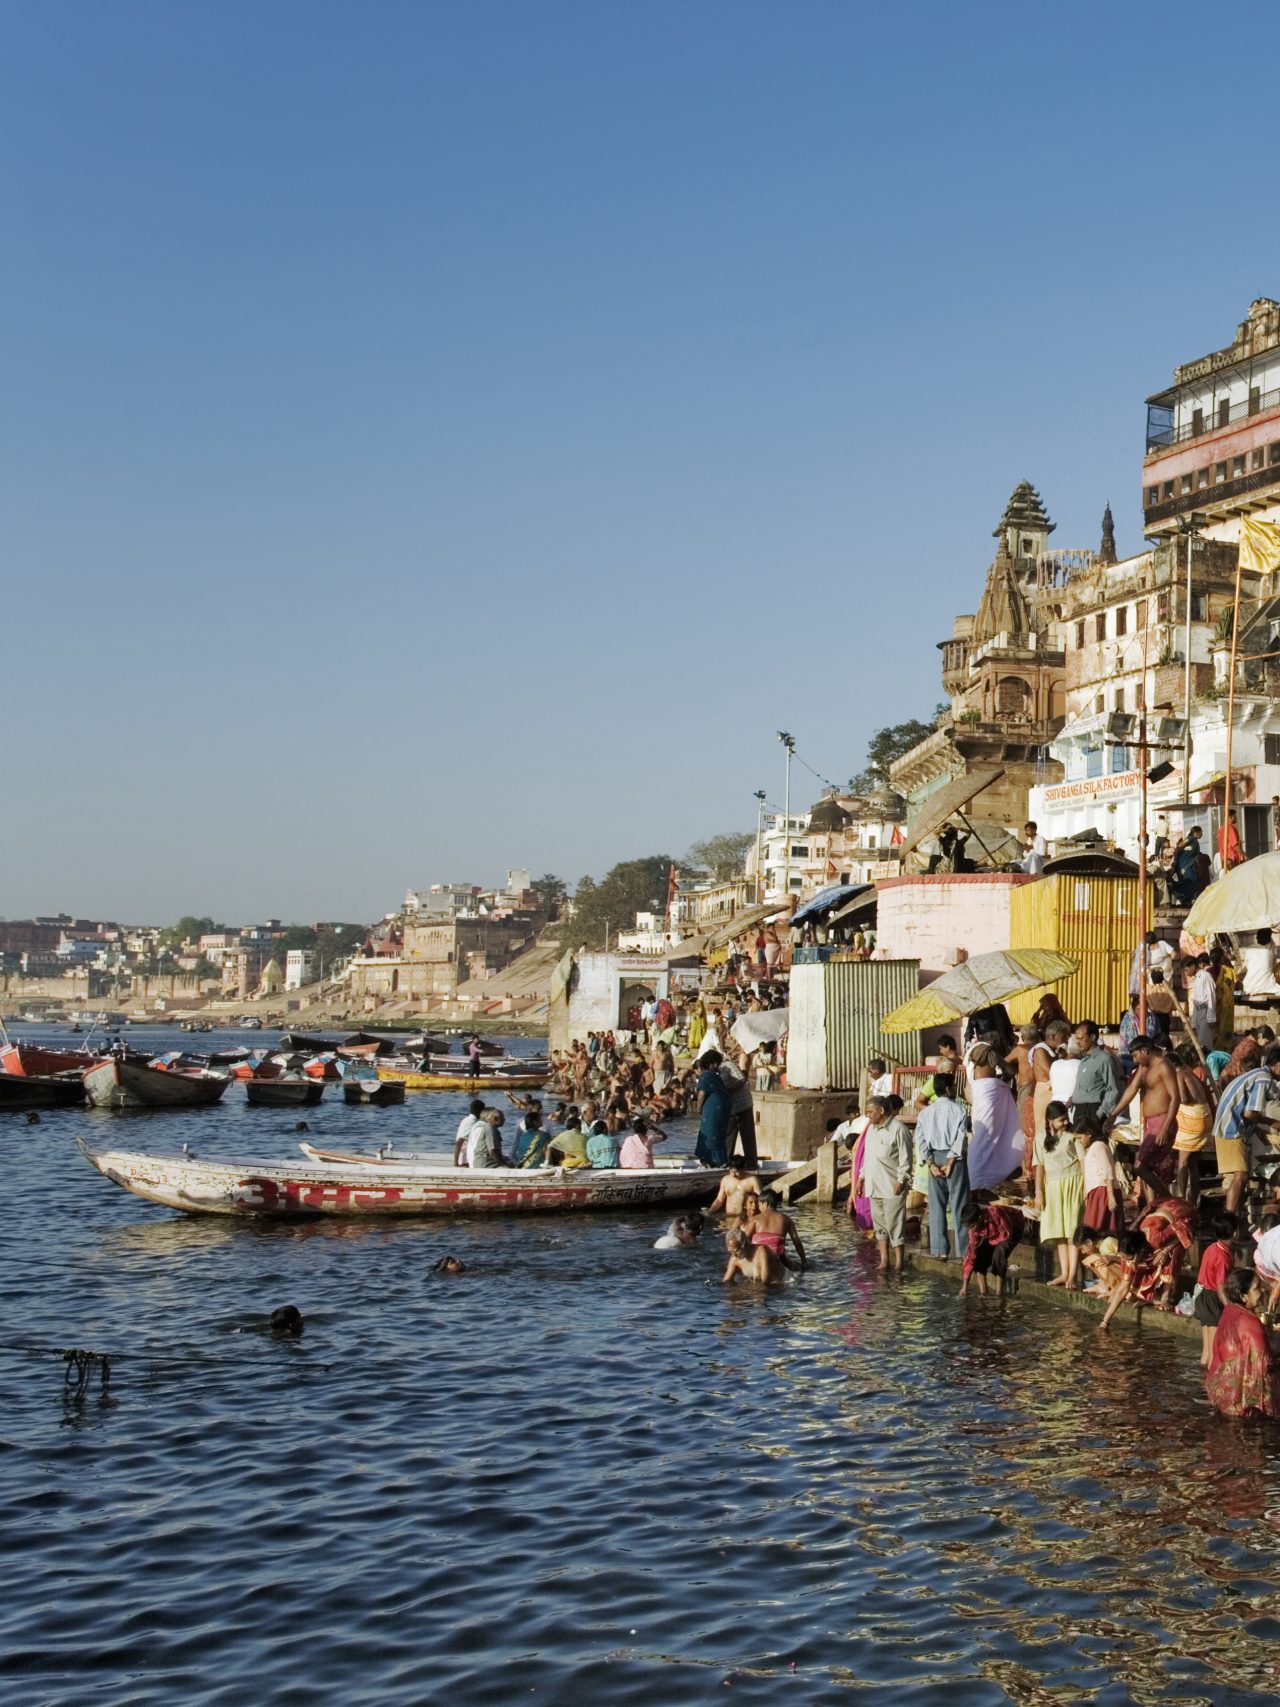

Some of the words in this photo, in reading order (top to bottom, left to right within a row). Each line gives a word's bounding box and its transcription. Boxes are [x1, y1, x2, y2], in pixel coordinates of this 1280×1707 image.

[1083, 779, 1102, 795] SILK
[1103, 771, 1141, 791] FACTORY
[237, 1177, 405, 1214] अमर
